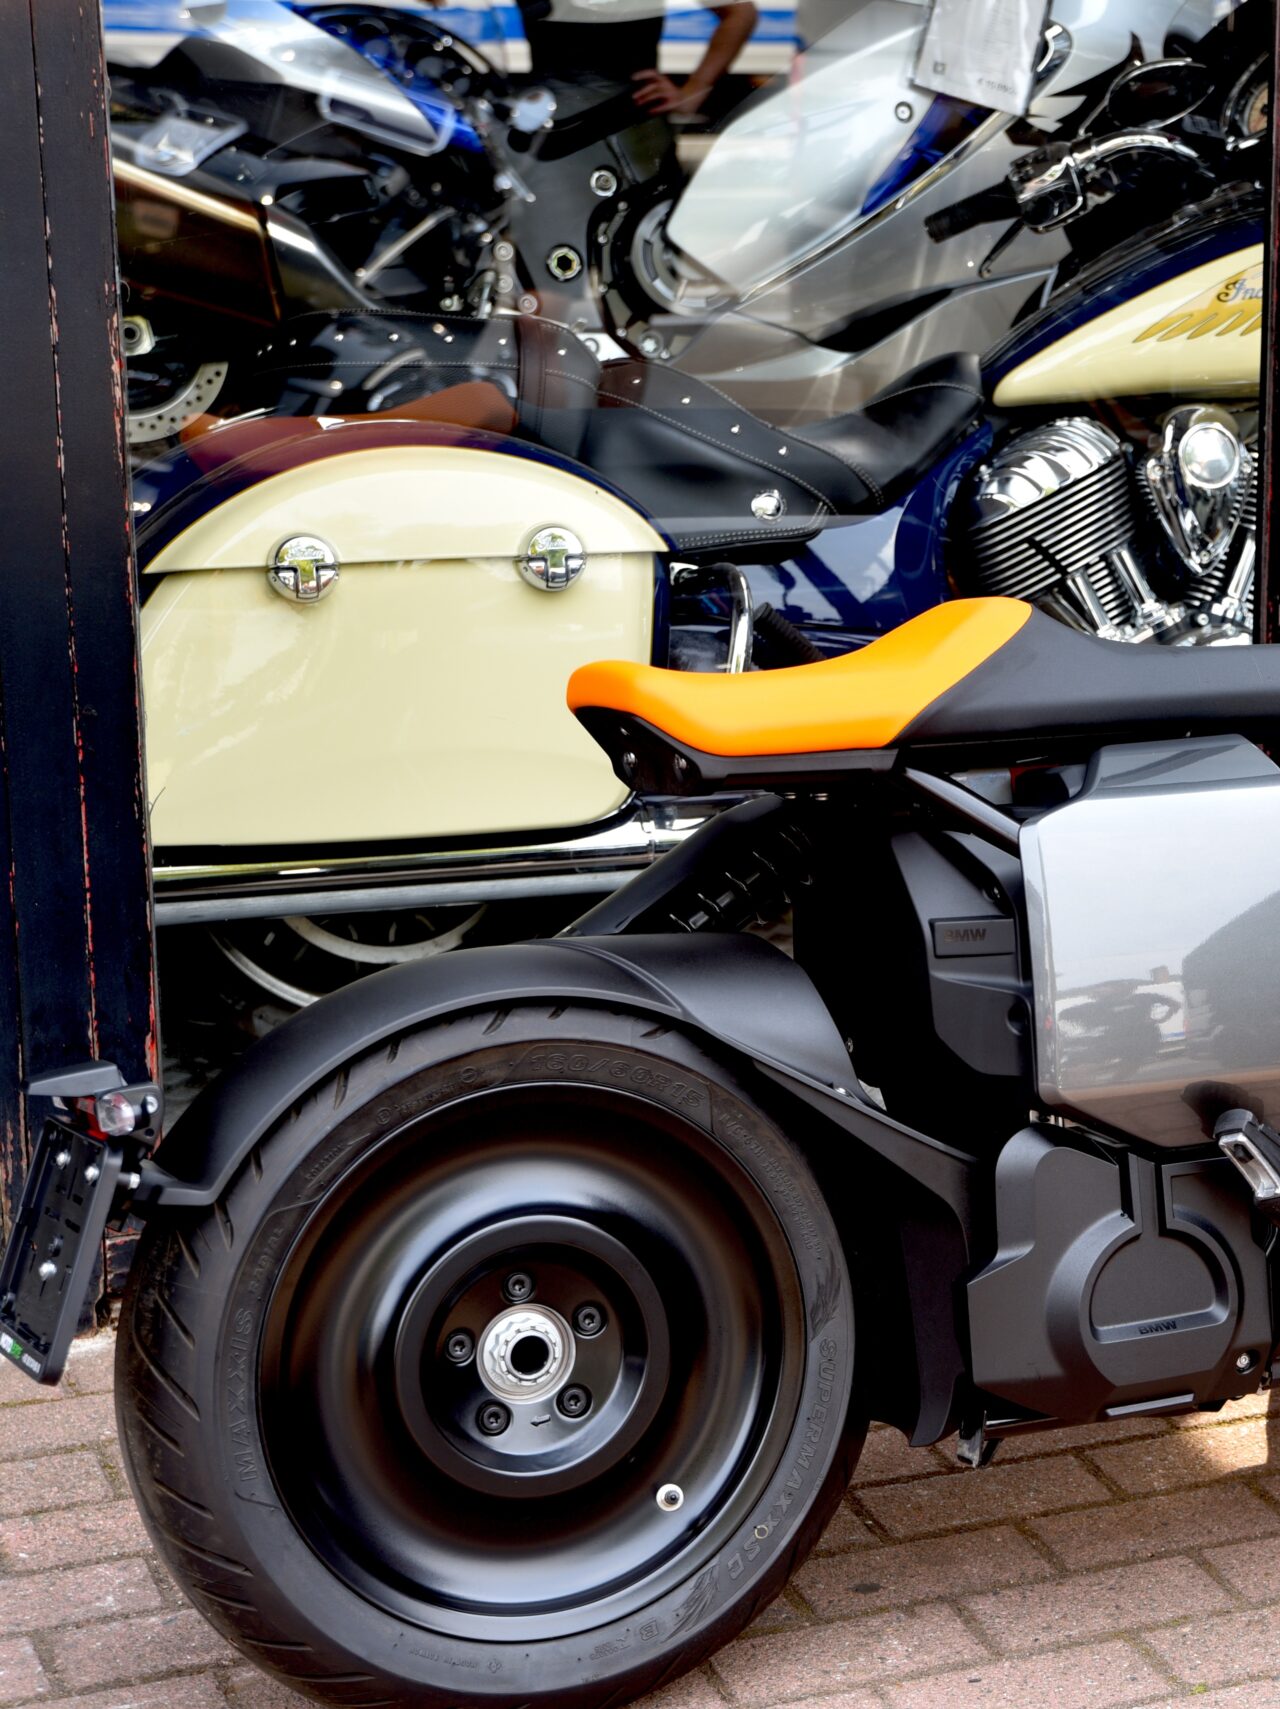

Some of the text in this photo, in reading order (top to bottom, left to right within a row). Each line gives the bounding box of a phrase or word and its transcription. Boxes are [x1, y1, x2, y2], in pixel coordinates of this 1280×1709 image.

[943, 927, 987, 943] BMW
[531, 1051, 706, 1109] 160/60R15
[1138, 1320, 1177, 1335] BMW
[227, 1225, 283, 1483] MAXXIS RADIAL
